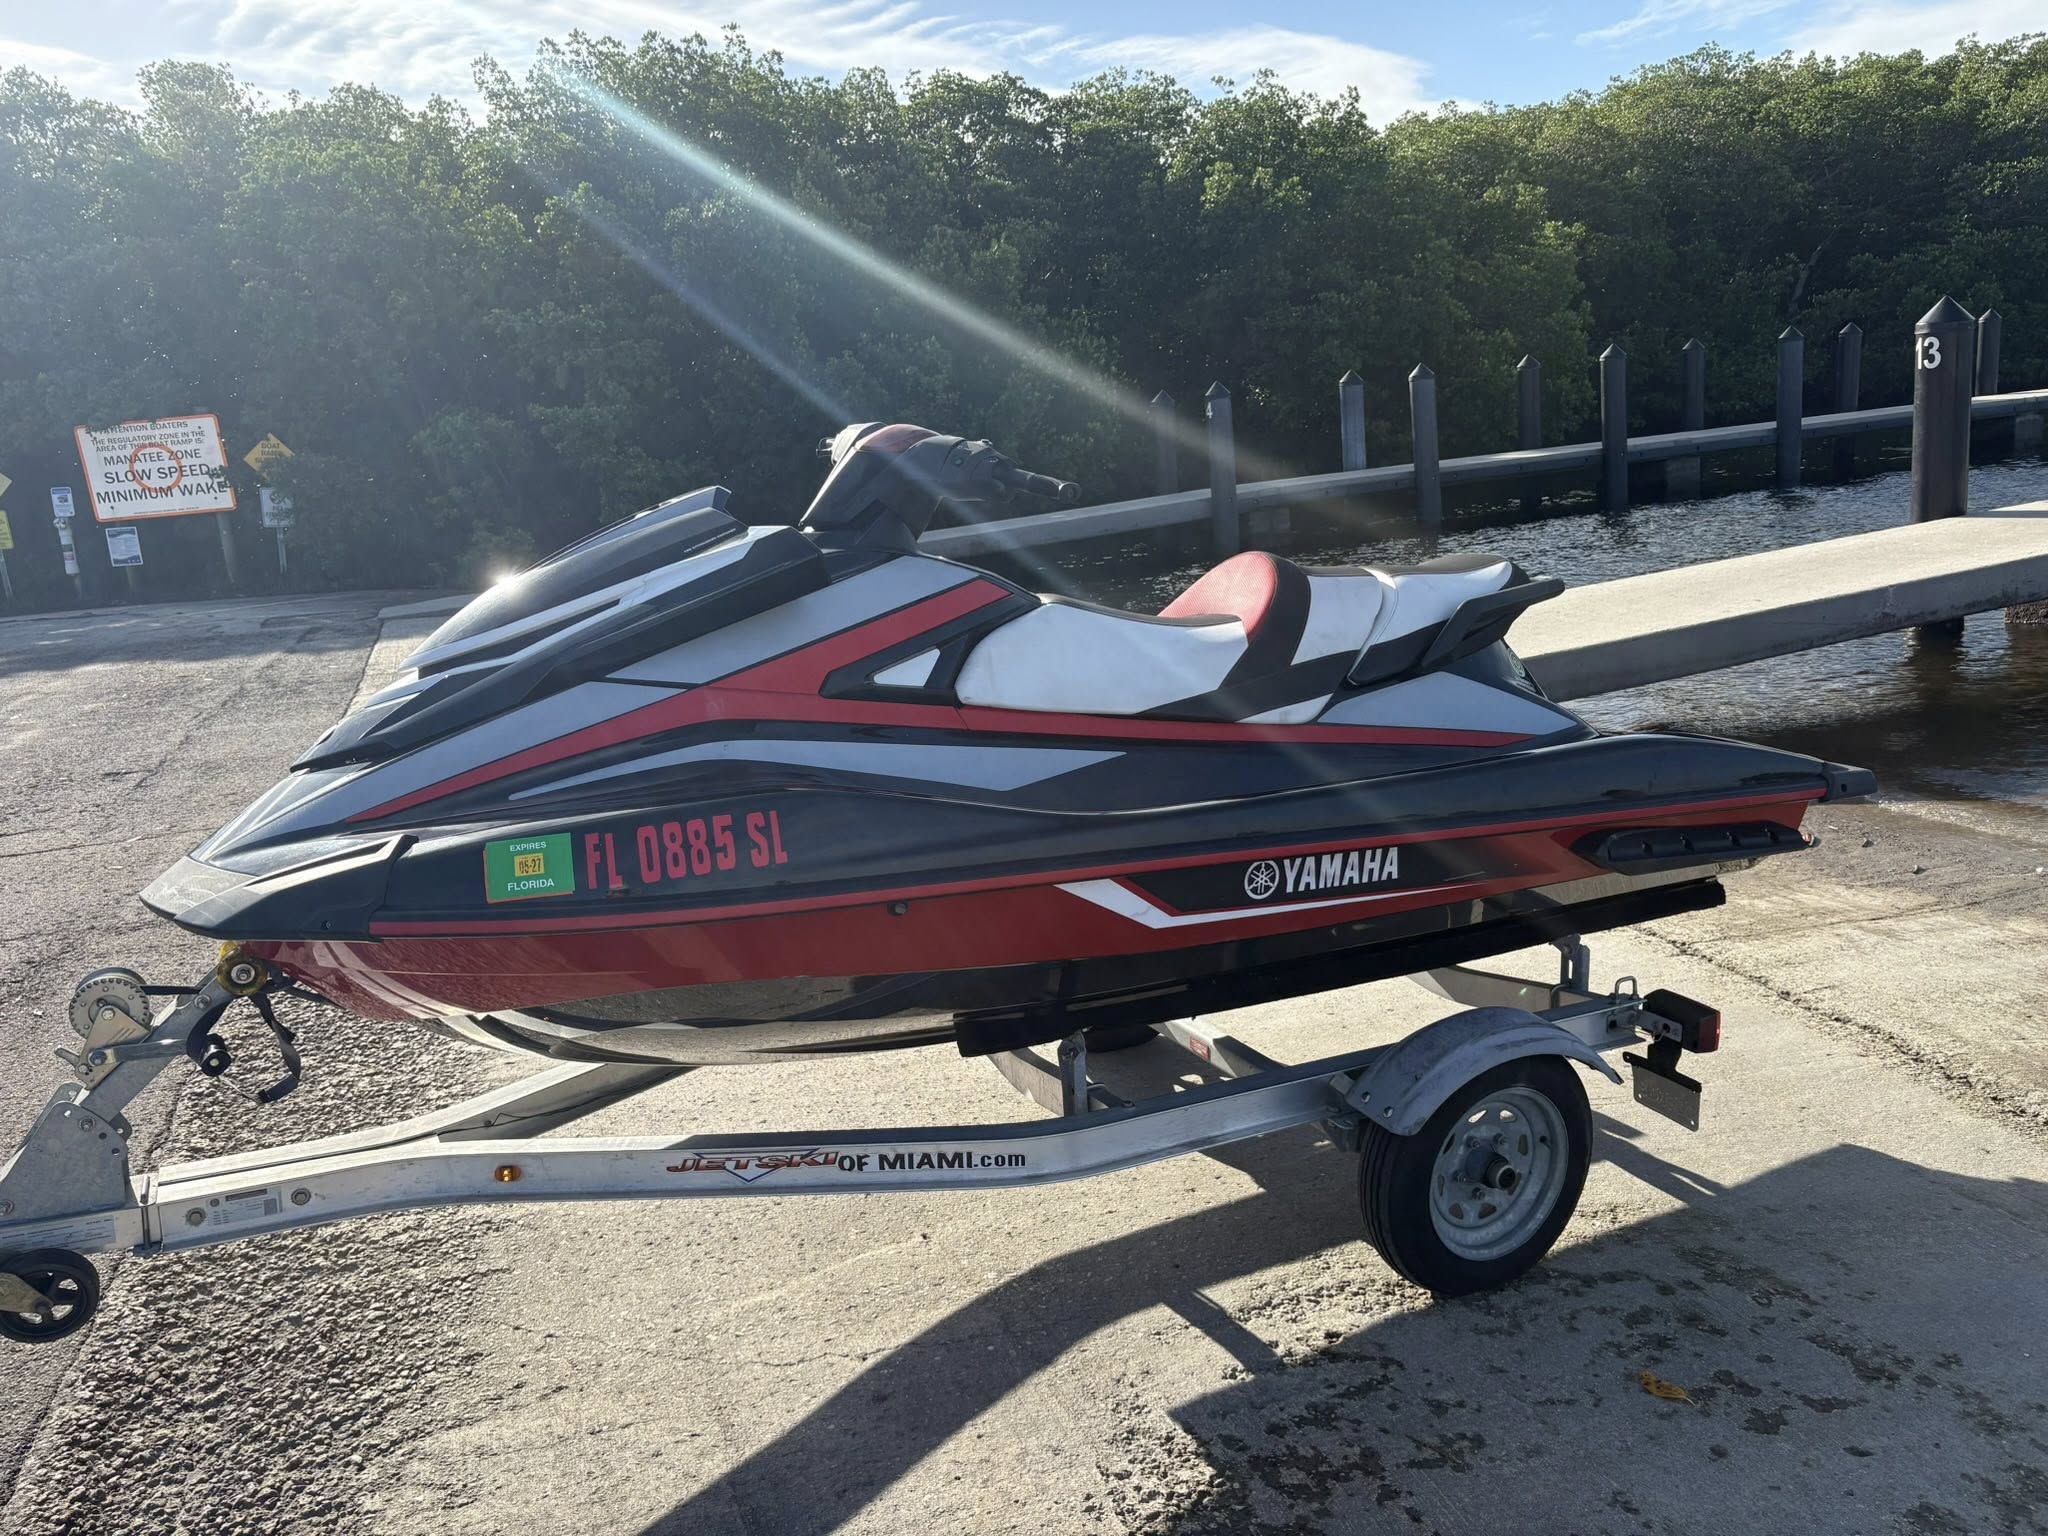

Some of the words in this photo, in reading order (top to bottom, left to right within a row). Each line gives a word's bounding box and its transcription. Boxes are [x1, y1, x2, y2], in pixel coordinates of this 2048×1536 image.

[1915, 336, 1941, 370] 13
[102, 424, 148, 434] ATTENTION
[150, 421, 188, 431] BOATERS
[96, 444, 117, 453] AREA
[170, 437, 193, 446] RAMP
[107, 434, 157, 444] REGULATORY
[159, 432, 179, 440] ZONE
[103, 451, 164, 466] MANATEE
[168, 448, 202, 461] ZONE
[104, 468, 152, 484] SLOW
[157, 463, 210, 479] SPEED
[96, 486, 174, 504] MINIMUM
[178, 480, 228, 496] WAKE
[510, 842, 546, 852] EXPIRES
[585, 833, 623, 889] FL
[637, 814, 736, 883] 0885
[746, 810, 788, 868] SL
[1283, 847, 1398, 893] YAMAHA
[507, 878, 554, 891] FLORIDA
[838, 1154, 870, 1172] OF
[878, 1152, 1026, 1171] MIAMI.com
